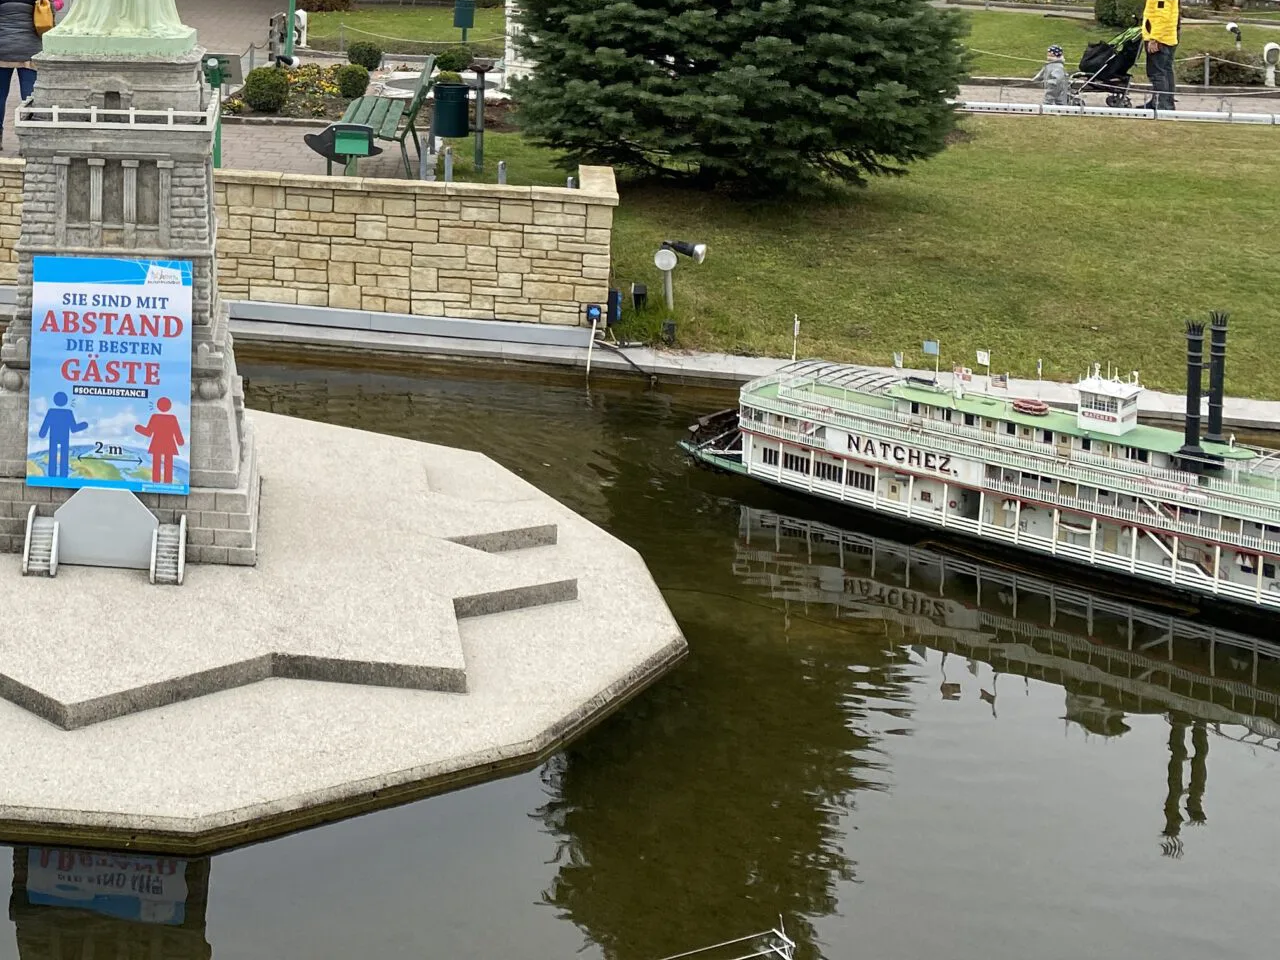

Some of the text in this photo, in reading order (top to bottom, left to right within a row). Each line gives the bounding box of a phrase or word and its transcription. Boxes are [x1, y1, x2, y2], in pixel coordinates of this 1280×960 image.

[62, 292, 169, 310] SIE SIND MIT
[40, 310, 184, 338] ABSTAND
[66, 338, 162, 356] DIE BESTEN
[61, 354, 161, 386] GÄSTE
[74, 387, 147, 398] #SOCIALDISTANCE
[94, 441, 123, 455] 2 m
